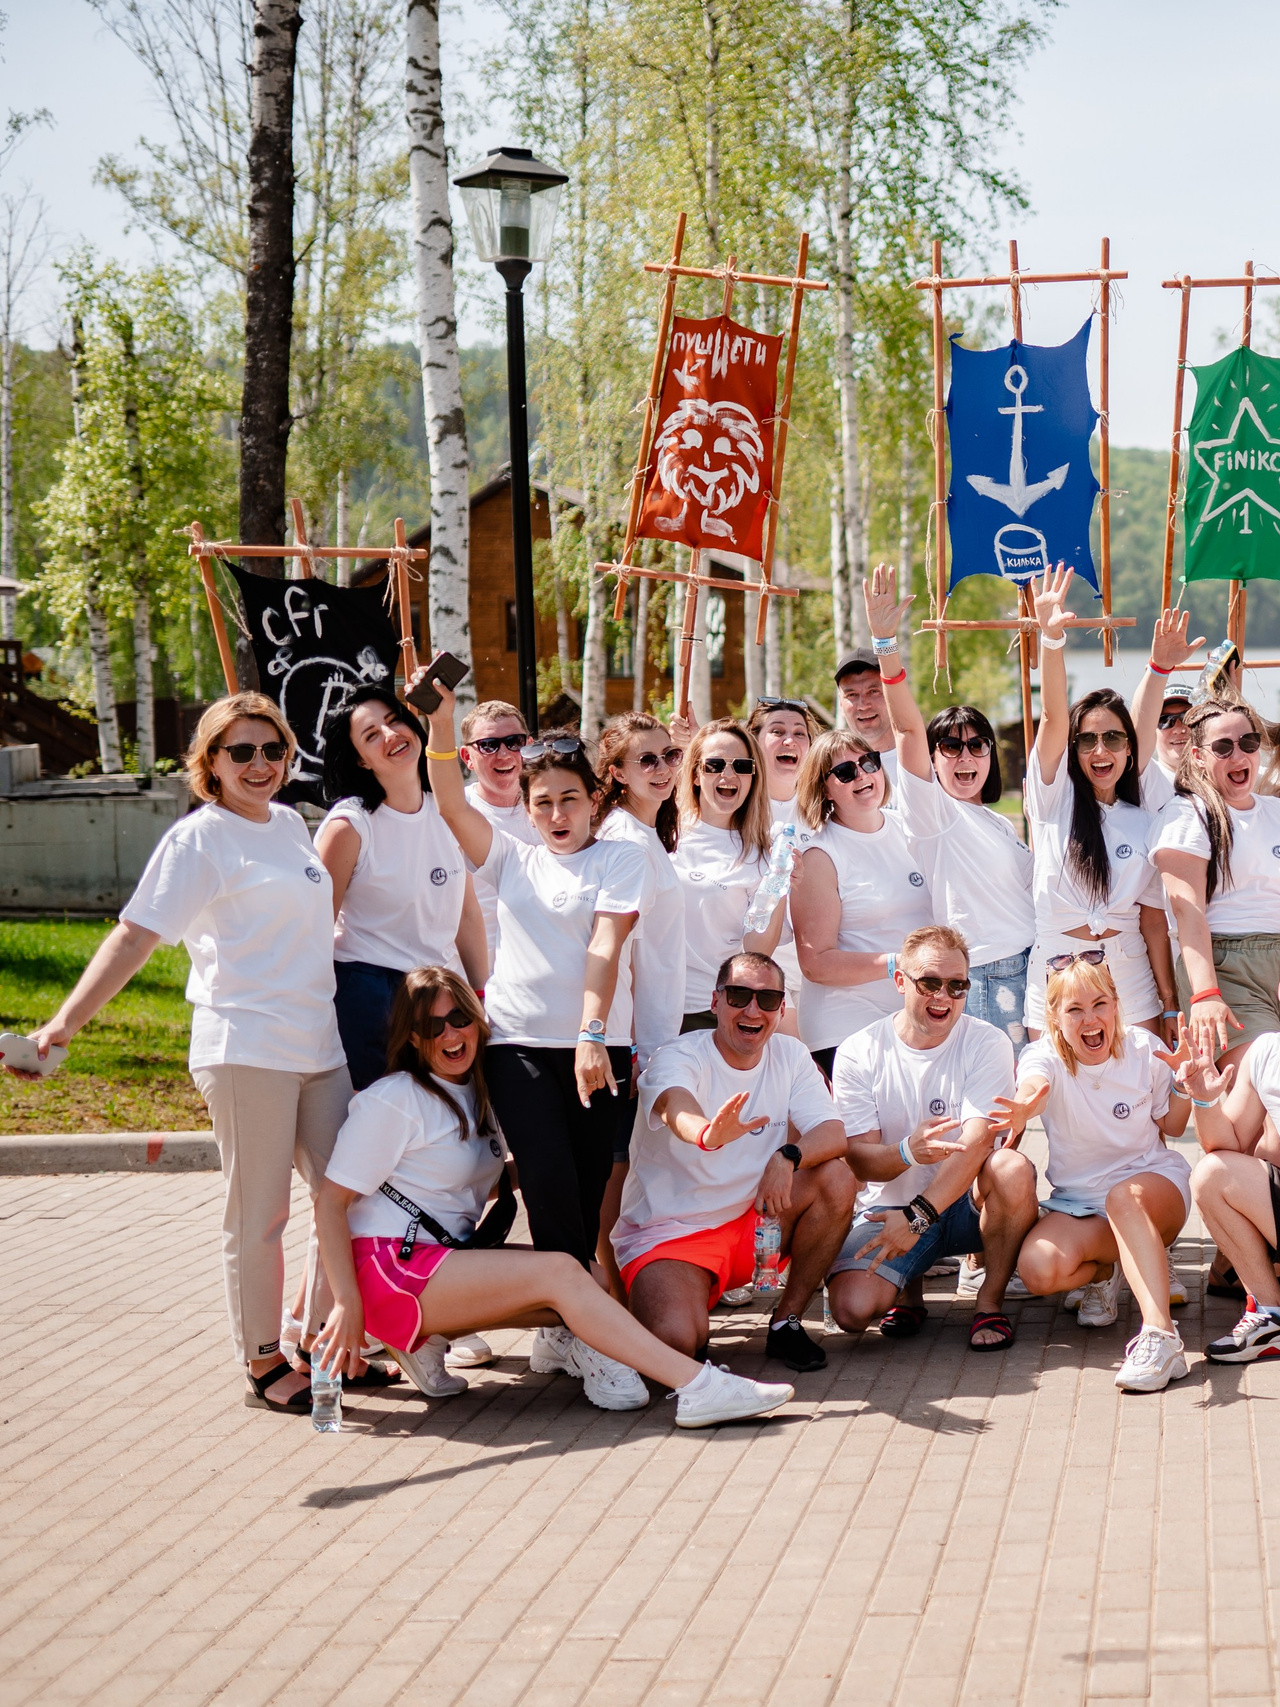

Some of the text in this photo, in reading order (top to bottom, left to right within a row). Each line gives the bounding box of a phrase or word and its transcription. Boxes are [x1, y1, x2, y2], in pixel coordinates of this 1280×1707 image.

[1239, 501, 1253, 534] 1
[1006, 556, 1042, 568] КИЛЬКА
[570, 894, 595, 904] FINIKO
[382, 1184, 421, 1217] KLEIN JEANS
